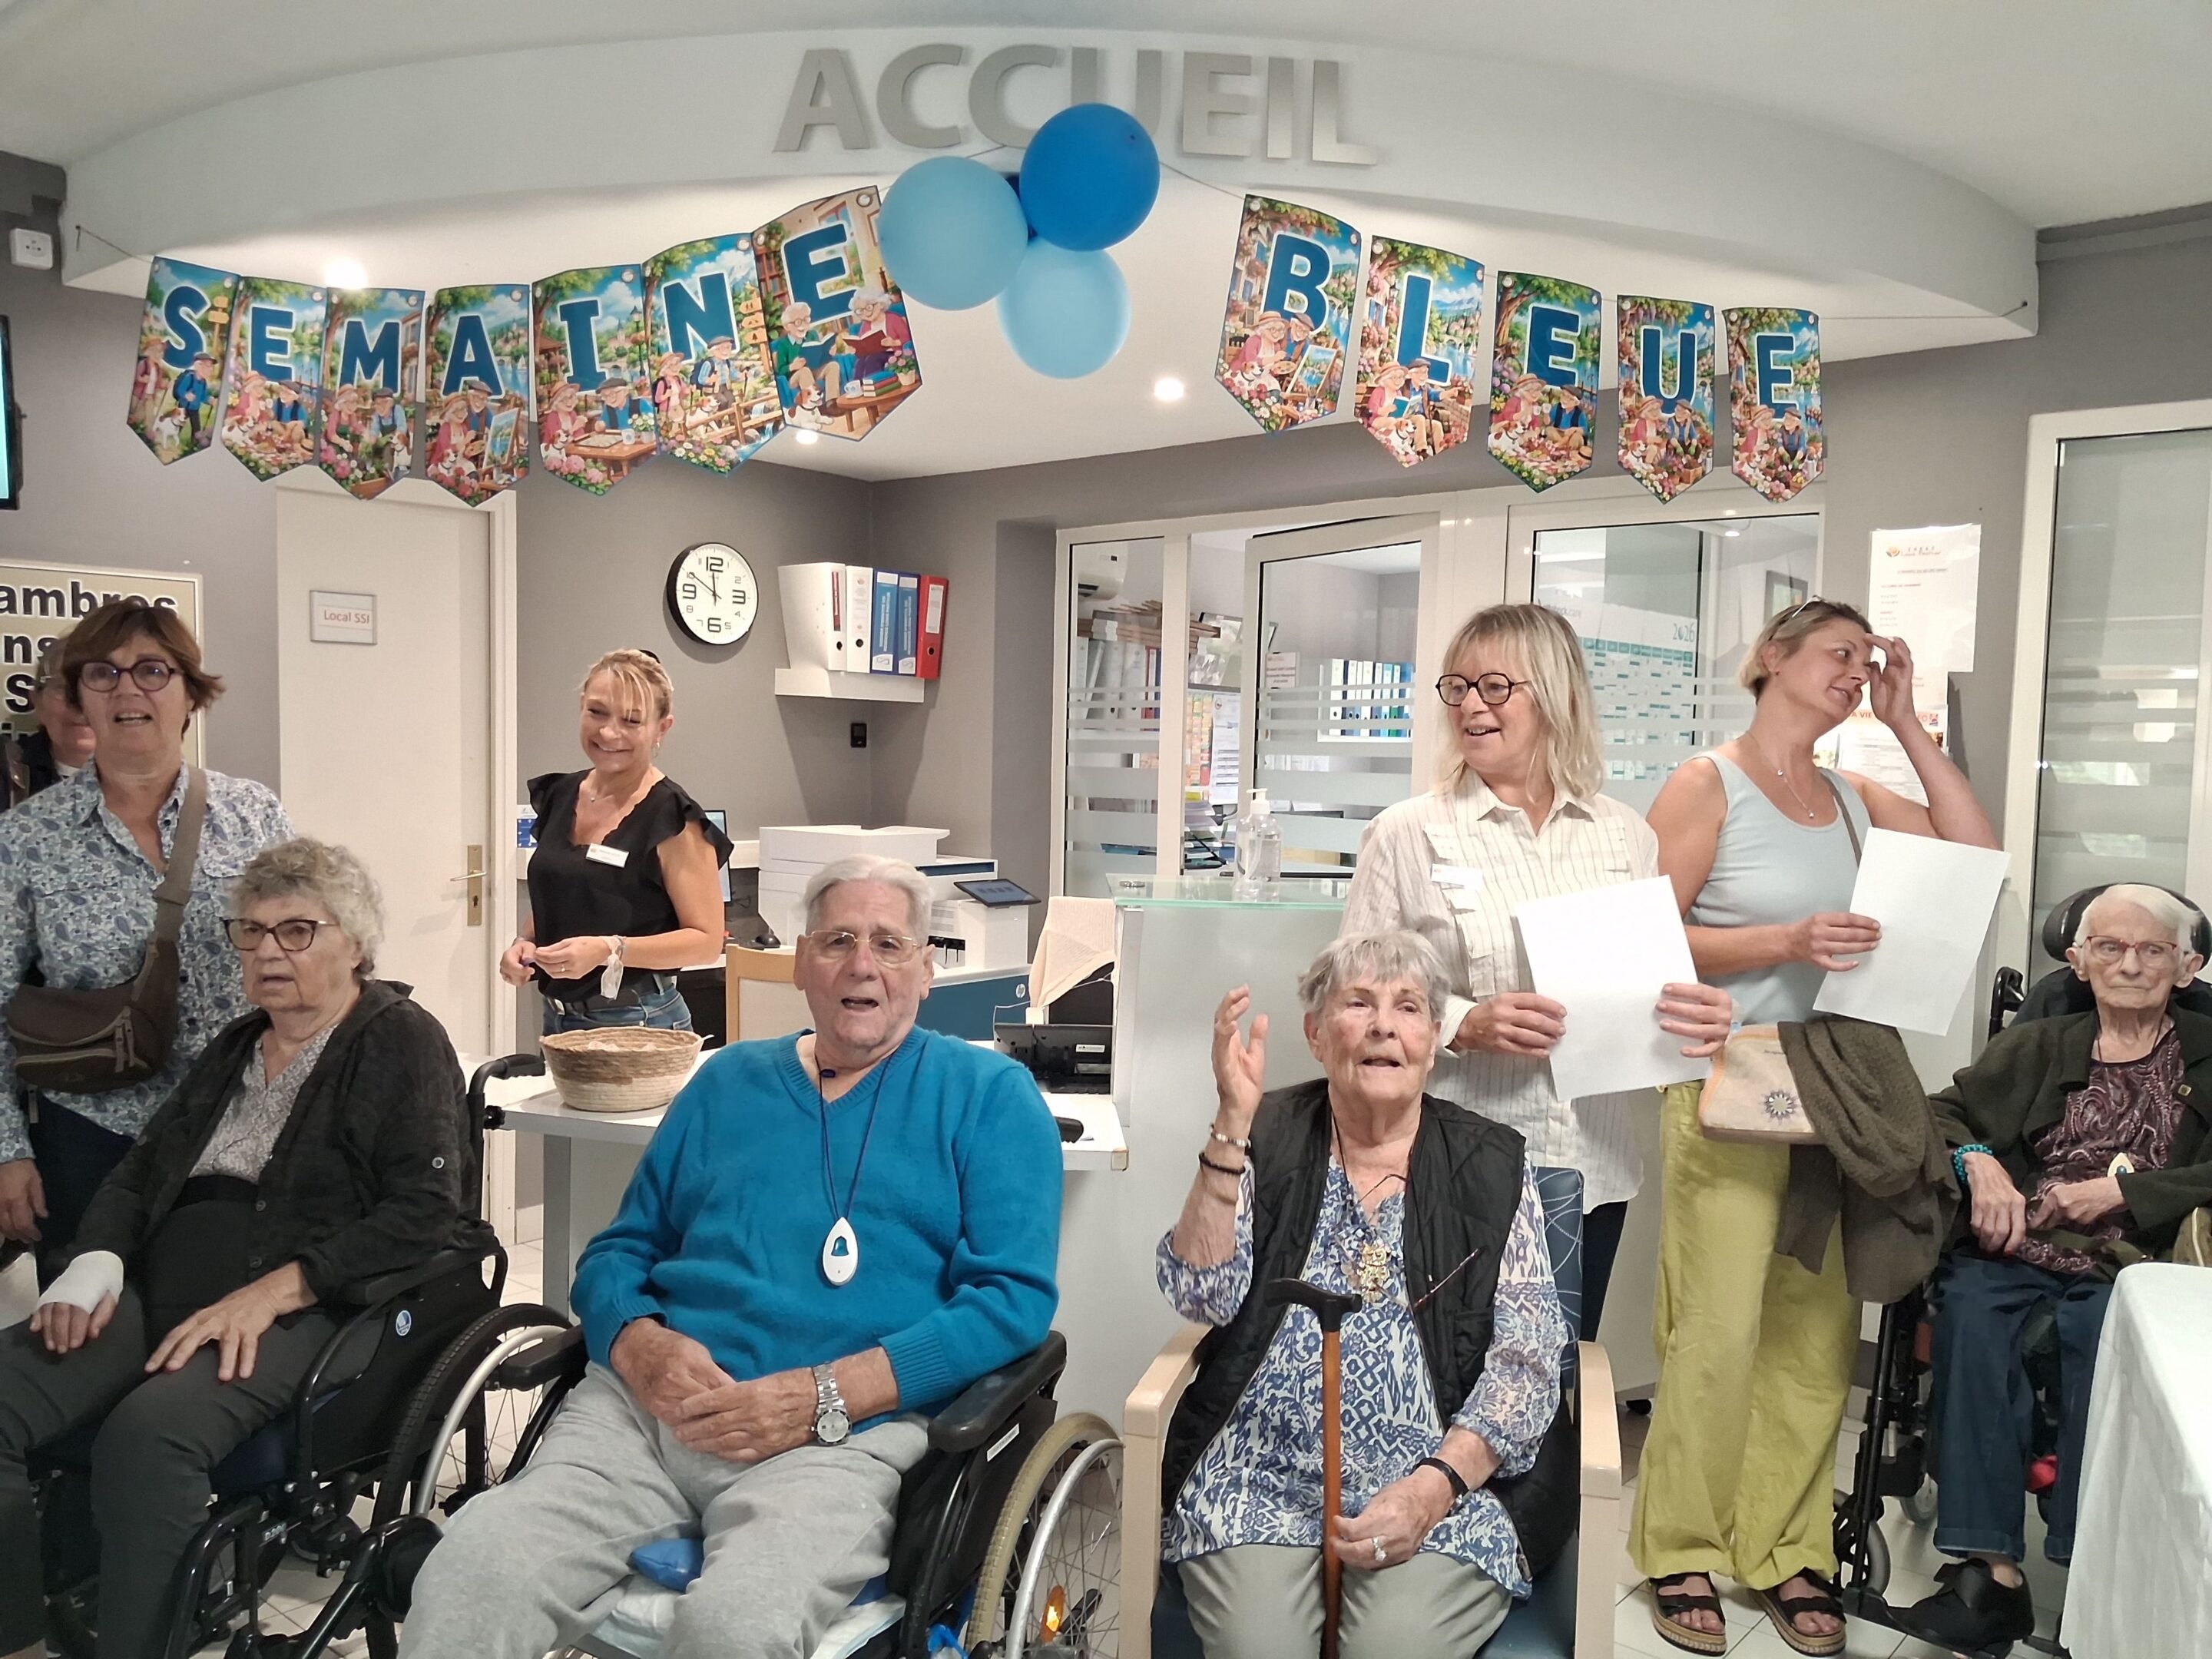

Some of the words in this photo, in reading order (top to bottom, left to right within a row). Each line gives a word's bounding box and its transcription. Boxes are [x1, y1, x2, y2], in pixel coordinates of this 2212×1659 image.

[772, 43, 1379, 166] ACCUEIL
[162, 222, 862, 399] SEMAINE
[1262, 233, 1799, 419] BLEUE
[706, 556, 724, 573] 12
[734, 576, 742, 584] 2
[682, 583, 697, 600] 9
[732, 589, 746, 604] 3
[323, 609, 351, 622] Local
[354, 613, 369, 624] SSI
[686, 605, 694, 614] 8
[707, 618, 721, 633] 6
